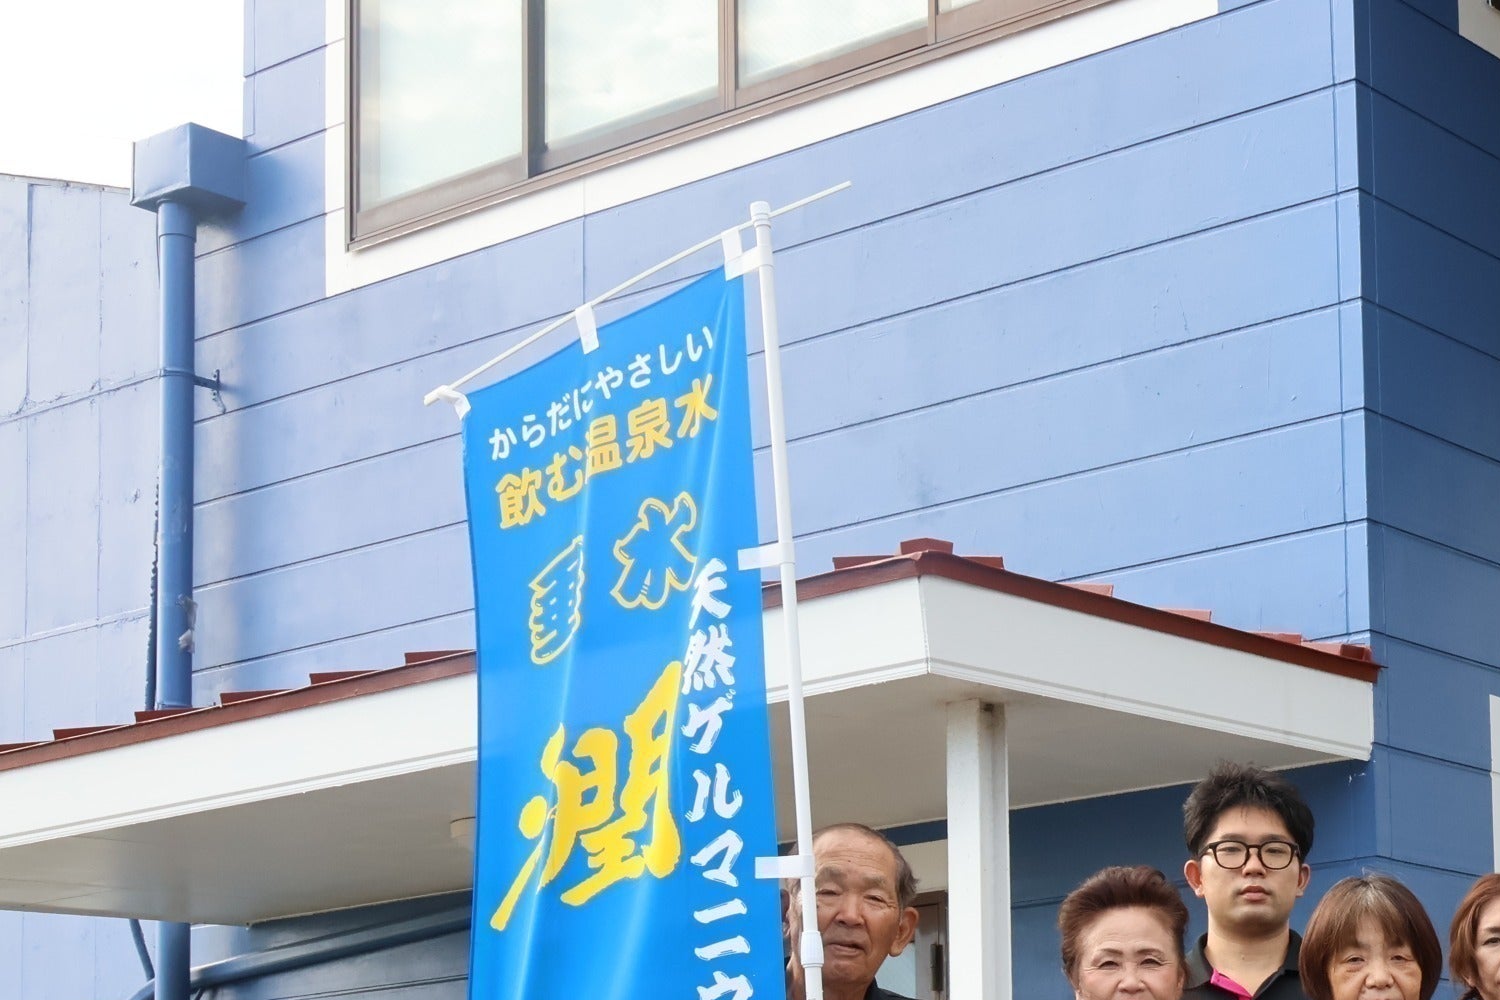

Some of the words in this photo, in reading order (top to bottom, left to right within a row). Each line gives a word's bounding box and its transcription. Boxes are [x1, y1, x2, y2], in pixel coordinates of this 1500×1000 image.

[489, 327, 713, 462] からだにやさしい
[495, 373, 719, 529] 飲む温泉水
